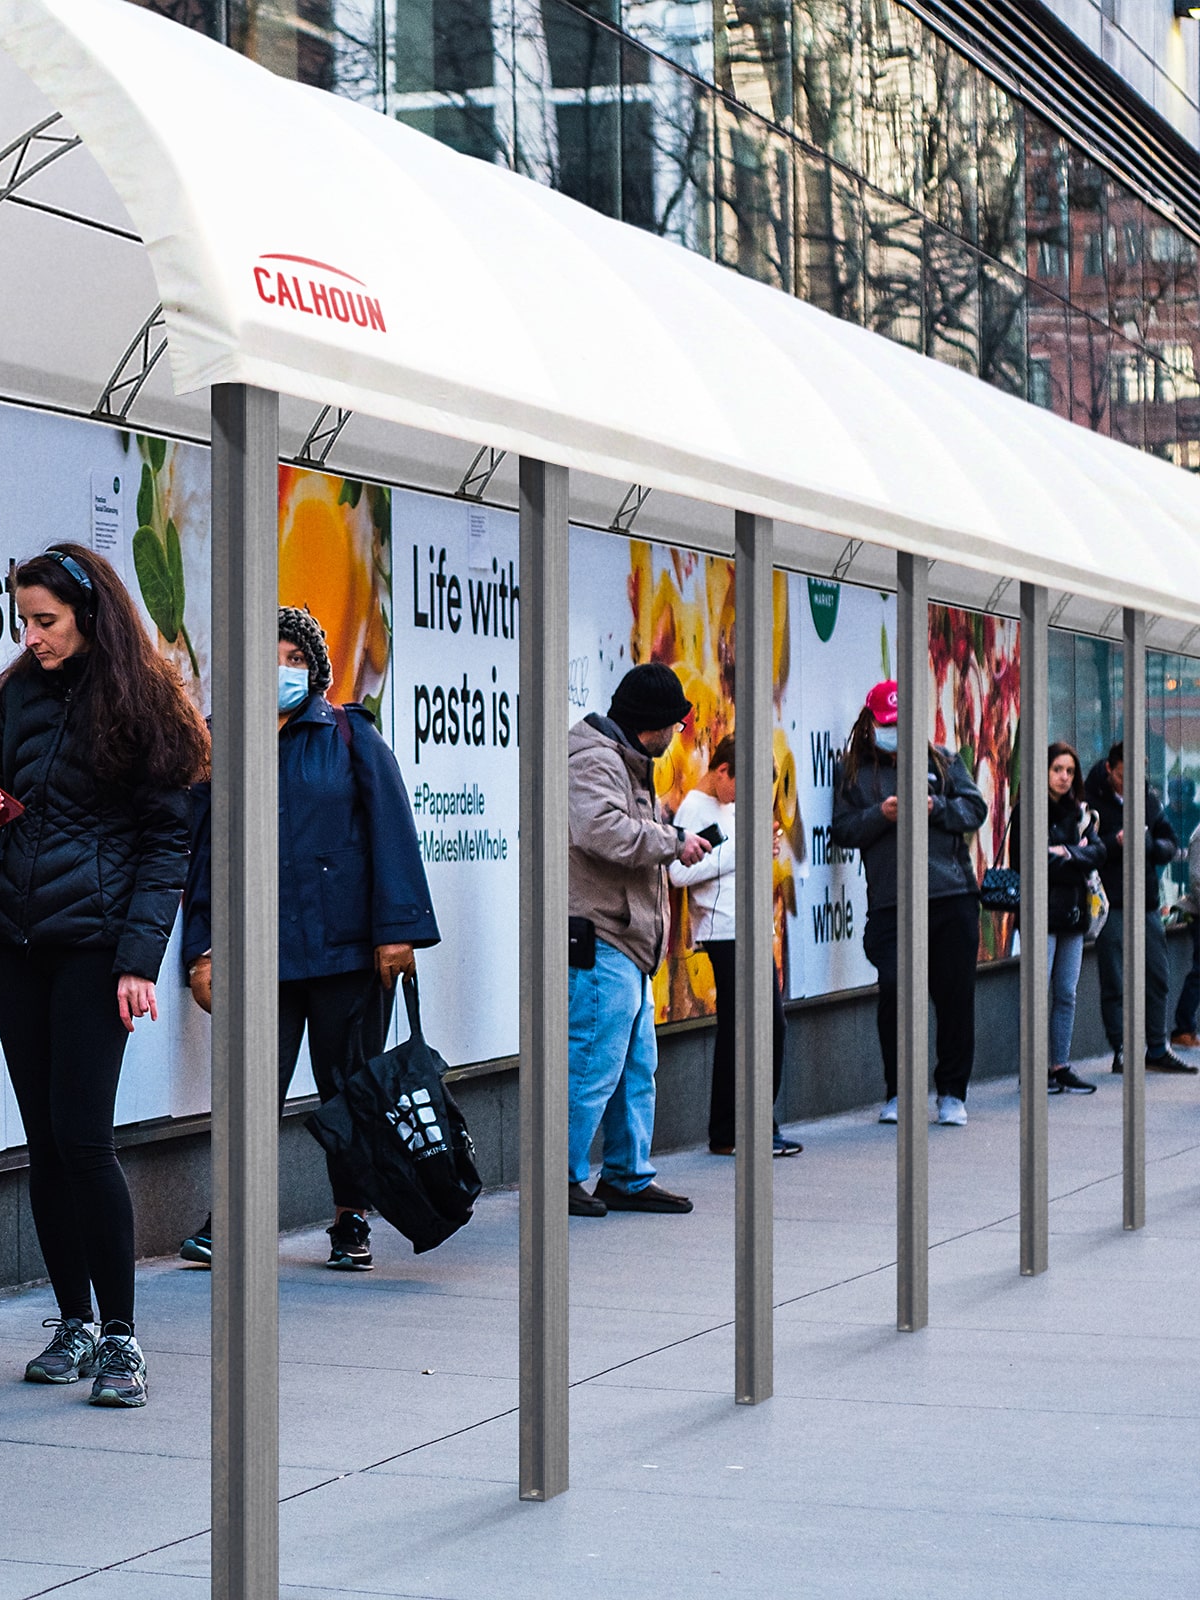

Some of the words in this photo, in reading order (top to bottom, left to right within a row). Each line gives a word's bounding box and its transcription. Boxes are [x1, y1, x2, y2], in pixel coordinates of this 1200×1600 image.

[253, 266, 387, 333] CALHOUN
[413, 544, 462, 633] Life
[468, 556, 519, 640] with
[414, 673, 485, 764] pasta
[492, 665, 510, 748] is
[414, 783, 485, 823] #Pappardelle
[812, 884, 853, 944] whole
